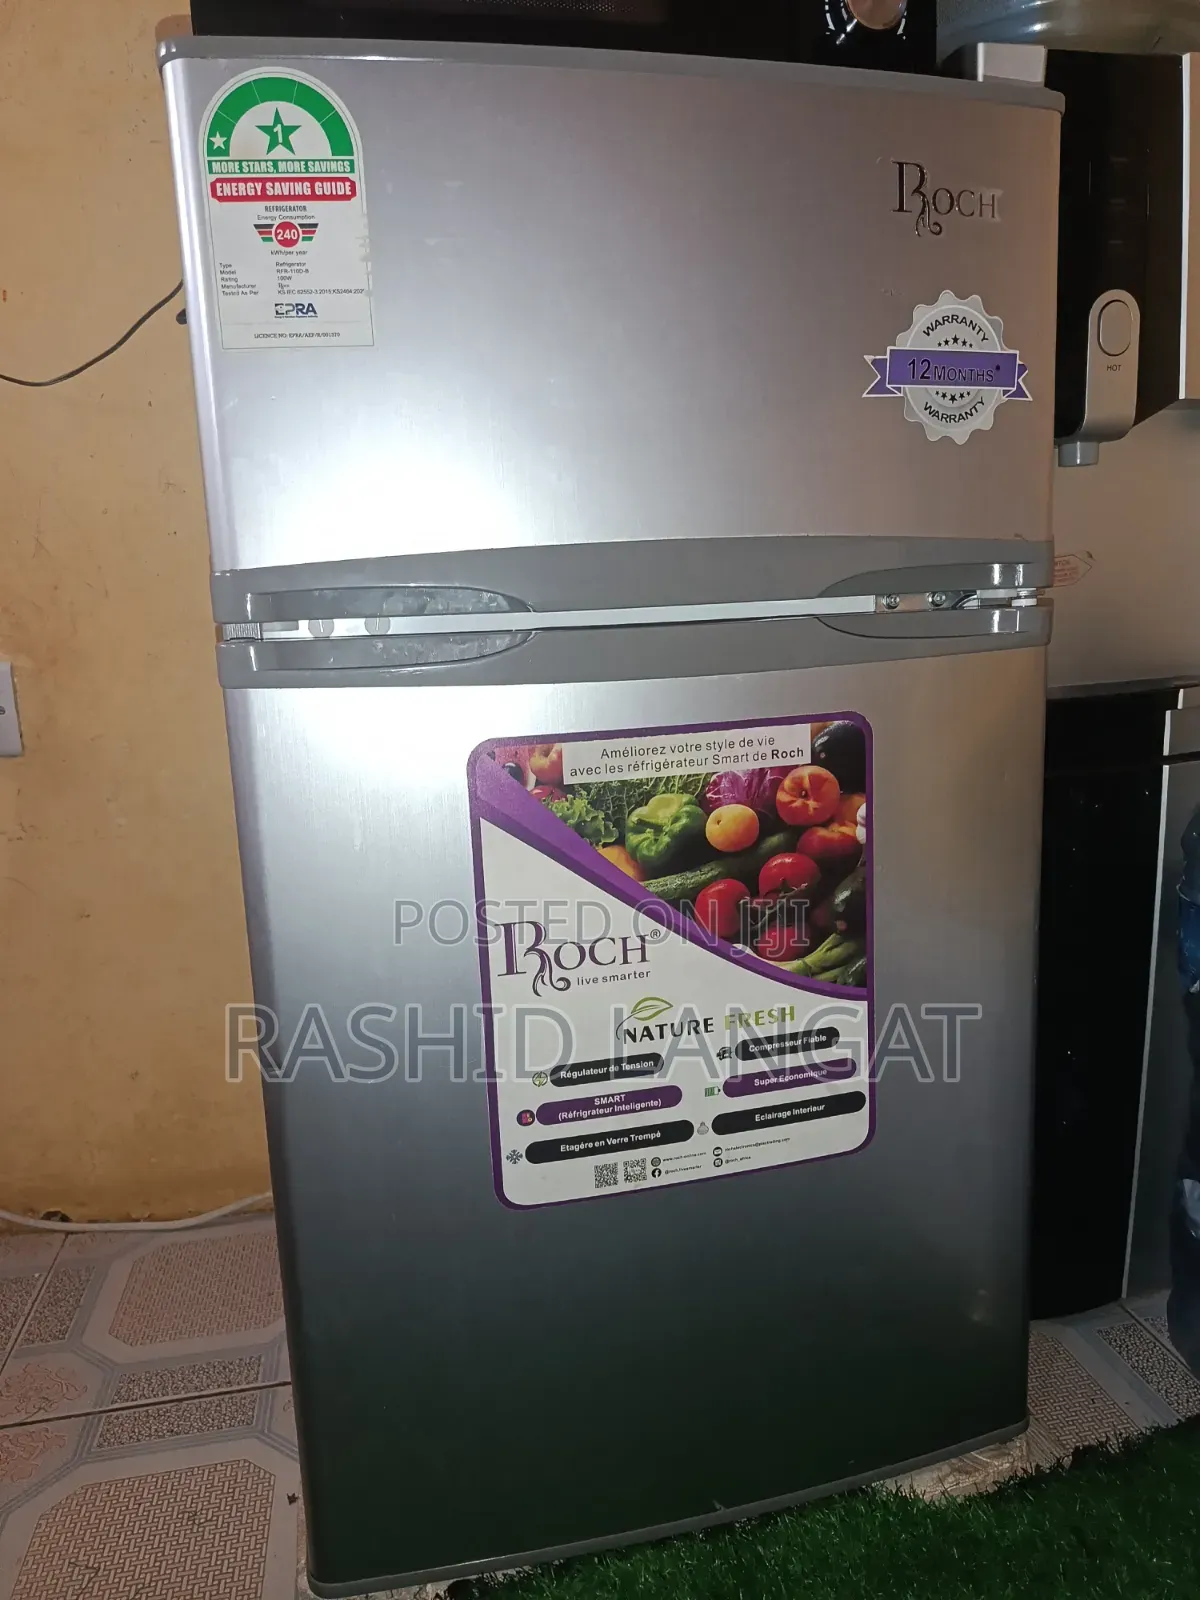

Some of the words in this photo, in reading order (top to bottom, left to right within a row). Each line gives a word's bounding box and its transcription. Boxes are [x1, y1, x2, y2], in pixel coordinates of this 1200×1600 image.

[273, 123, 283, 143] 1
[212, 161, 240, 174] MORE
[242, 161, 276, 174] STARS,
[278, 161, 306, 173] MORE
[307, 160, 351, 173] SAVINGS
[216, 182, 263, 197] ENERGY
[265, 182, 312, 196] SAVING
[314, 181, 352, 195] GUIDE
[257, 214, 277, 222] Energy
[278, 213, 316, 221] Consumption
[264, 205, 308, 213] REFRIGERATOR
[276, 229, 298, 240] 240
[274, 302, 318, 315] EPRA
[922, 313, 989, 343] WARRANTY
[907, 357, 932, 380] 12
[1106, 364, 1122, 372] HOT
[923, 396, 986, 424] WARRANTY
[600, 745, 667, 761] Améliorez
[670, 743, 702, 754] votre
[705, 738, 736, 753] style
[738, 736, 755, 748] de
[757, 735, 776, 746] vie
[569, 765, 602, 778] avec
[604, 762, 624, 775] les
[627, 755, 709, 774] réfrigérateur
[712, 752, 750, 766] Smart
[752, 750, 768, 763] de
[770, 746, 805, 760] Roch
[576, 974, 599, 987] live
[601, 968, 651, 984] smarter
[622, 1016, 715, 1045] NATURE
[724, 1005, 796, 1031] FRESH
[749, 1038, 802, 1053] Compresseur
[802, 1033, 827, 1044] Fiable
[560, 1064, 608, 1079] Régulateur
[608, 1063, 620, 1073] de
[620, 1059, 655, 1072] Tension
[753, 1076, 778, 1088] Super
[778, 1067, 828, 1083] Economique
[593, 1093, 626, 1106] SMART
[754, 1109, 792, 1123] Eclairage
[792, 1103, 826, 1116] Interieur
[594, 1138, 605, 1148] en
[606, 1135, 629, 1147] Verre
[629, 1130, 662, 1144] Trempé
